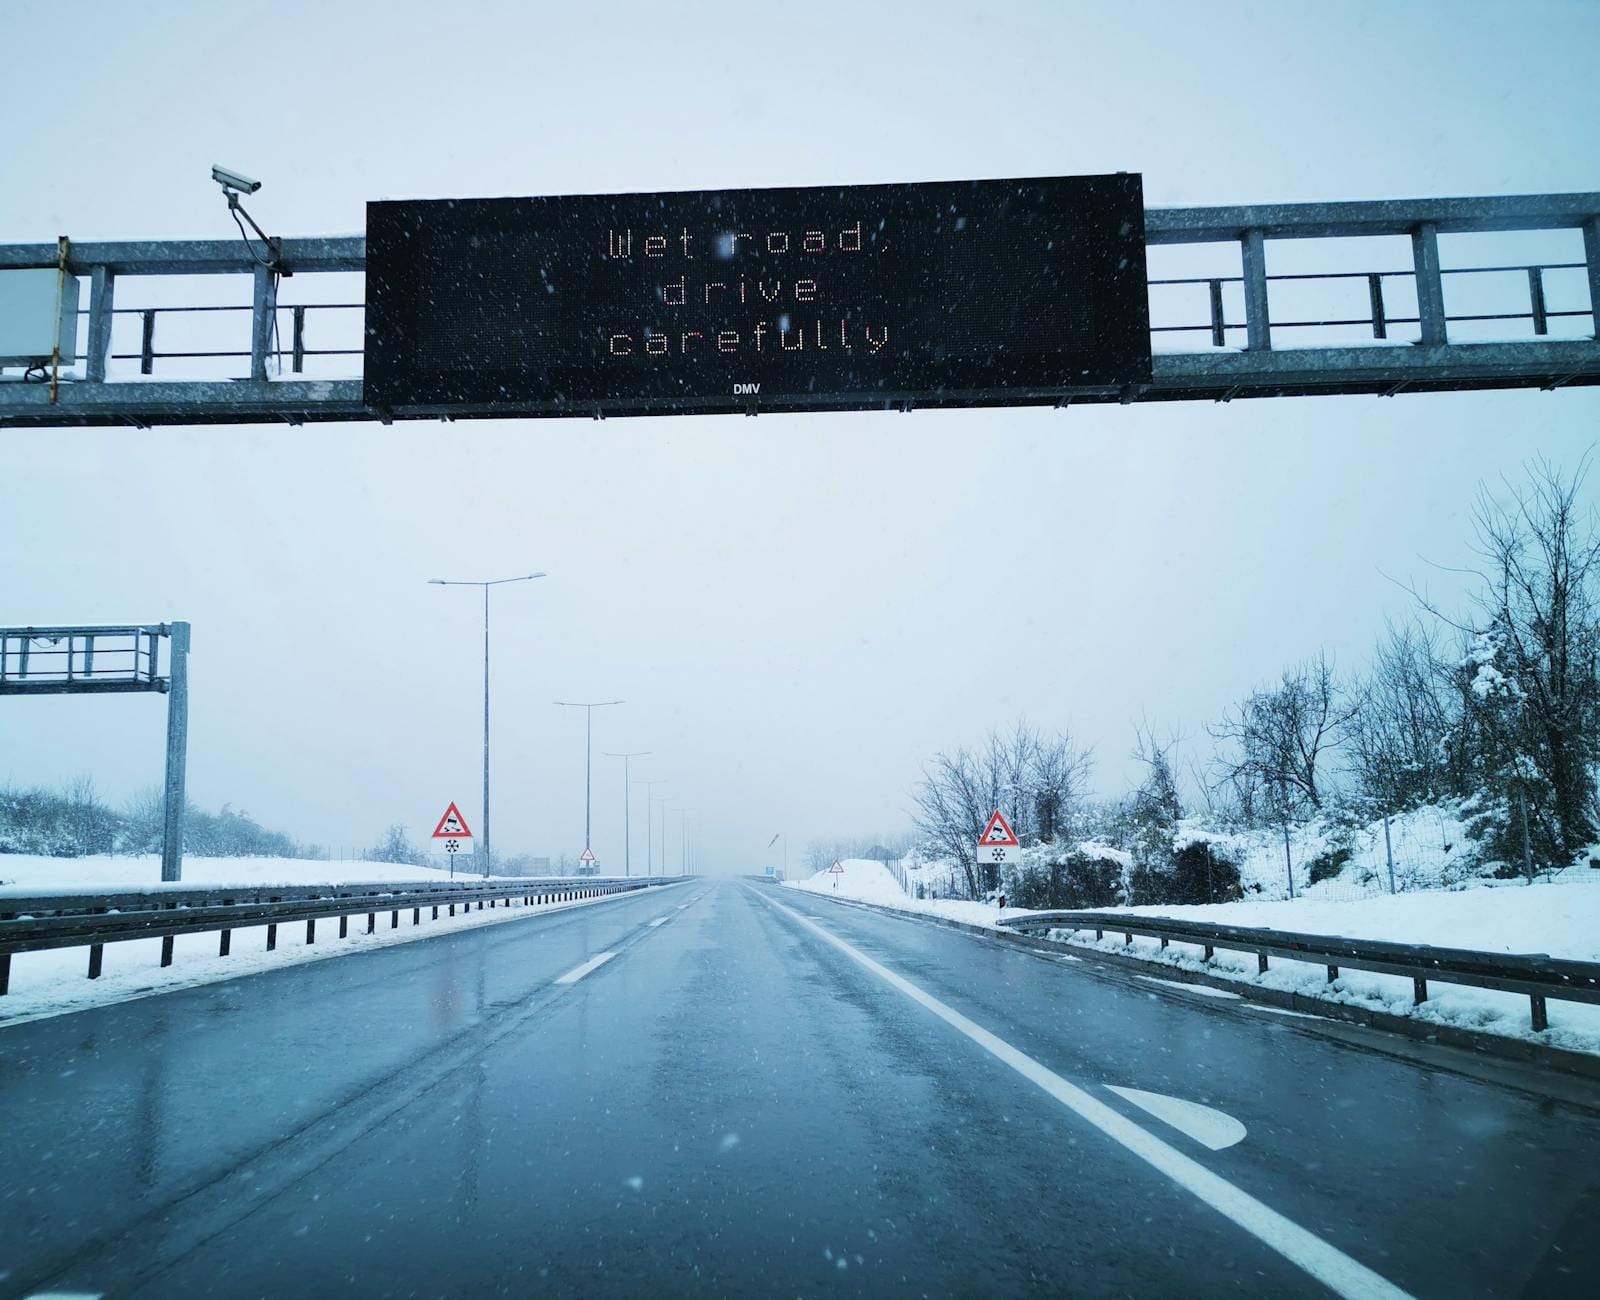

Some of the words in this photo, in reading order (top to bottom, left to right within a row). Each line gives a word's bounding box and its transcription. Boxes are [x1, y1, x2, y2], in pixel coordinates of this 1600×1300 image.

[609, 227, 694, 259] Wet
[663, 273, 817, 305] drive
[609, 319, 888, 355] carefully
[733, 383, 761, 395] DMV
